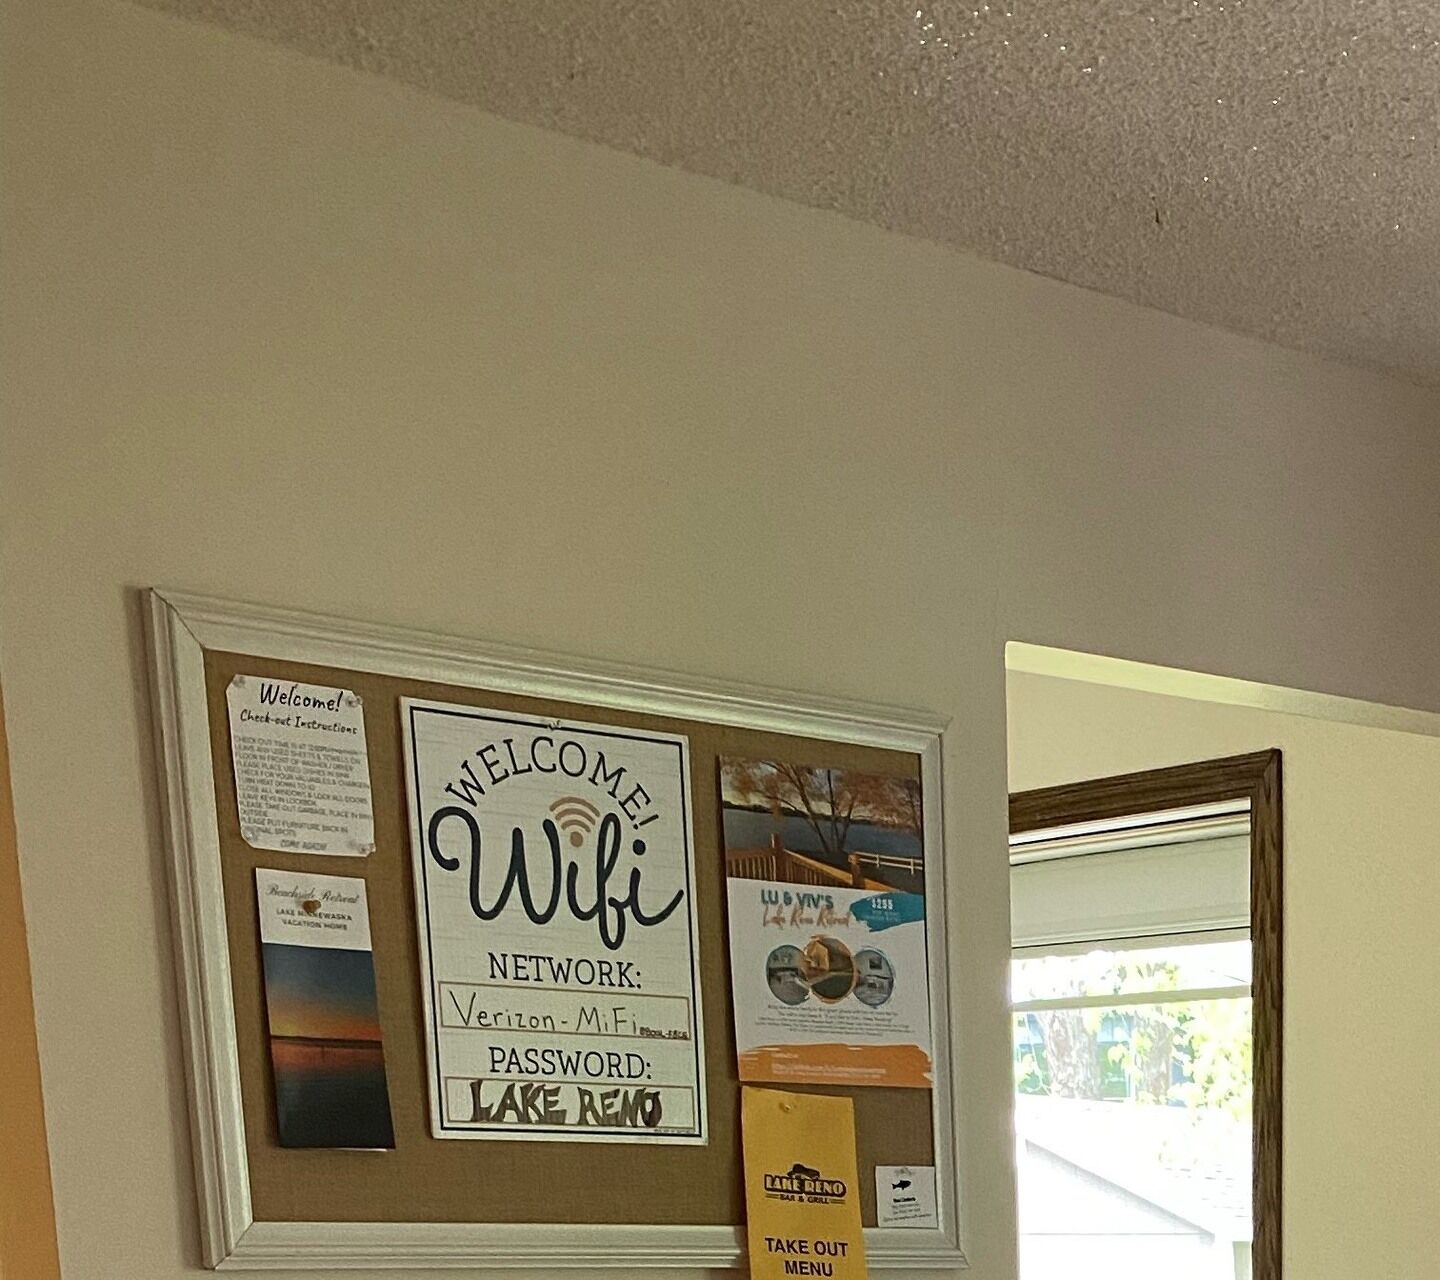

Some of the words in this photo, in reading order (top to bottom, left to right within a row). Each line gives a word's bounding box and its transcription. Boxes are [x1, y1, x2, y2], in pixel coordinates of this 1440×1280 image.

[260, 683, 343, 712] Welcome!
[240, 709, 290, 725] Check-out
[295, 716, 357, 734] Instructions
[444, 736, 659, 830] WELCOME!
[428, 806, 684, 950] Wifi
[761, 889, 778, 905] LU
[276, 908, 296, 916] LAKE
[282, 919, 322, 929] VACATION
[324, 923, 348, 931] HOME
[488, 952, 642, 989] NETWORK:
[488, 1046, 652, 1079] PASSWORD:
[470, 1079, 567, 1124] LAKE
[577, 1086, 662, 1128] RENO
[765, 1175, 801, 1193] LAKE
[804, 1179, 845, 1197] RENO
[780, 1194, 795, 1202] BAR
[808, 1196, 830, 1204] GRILL
[764, 1237, 810, 1255] TAKE
[814, 1240, 848, 1257] OUT
[784, 1260, 833, 1277] MENU
